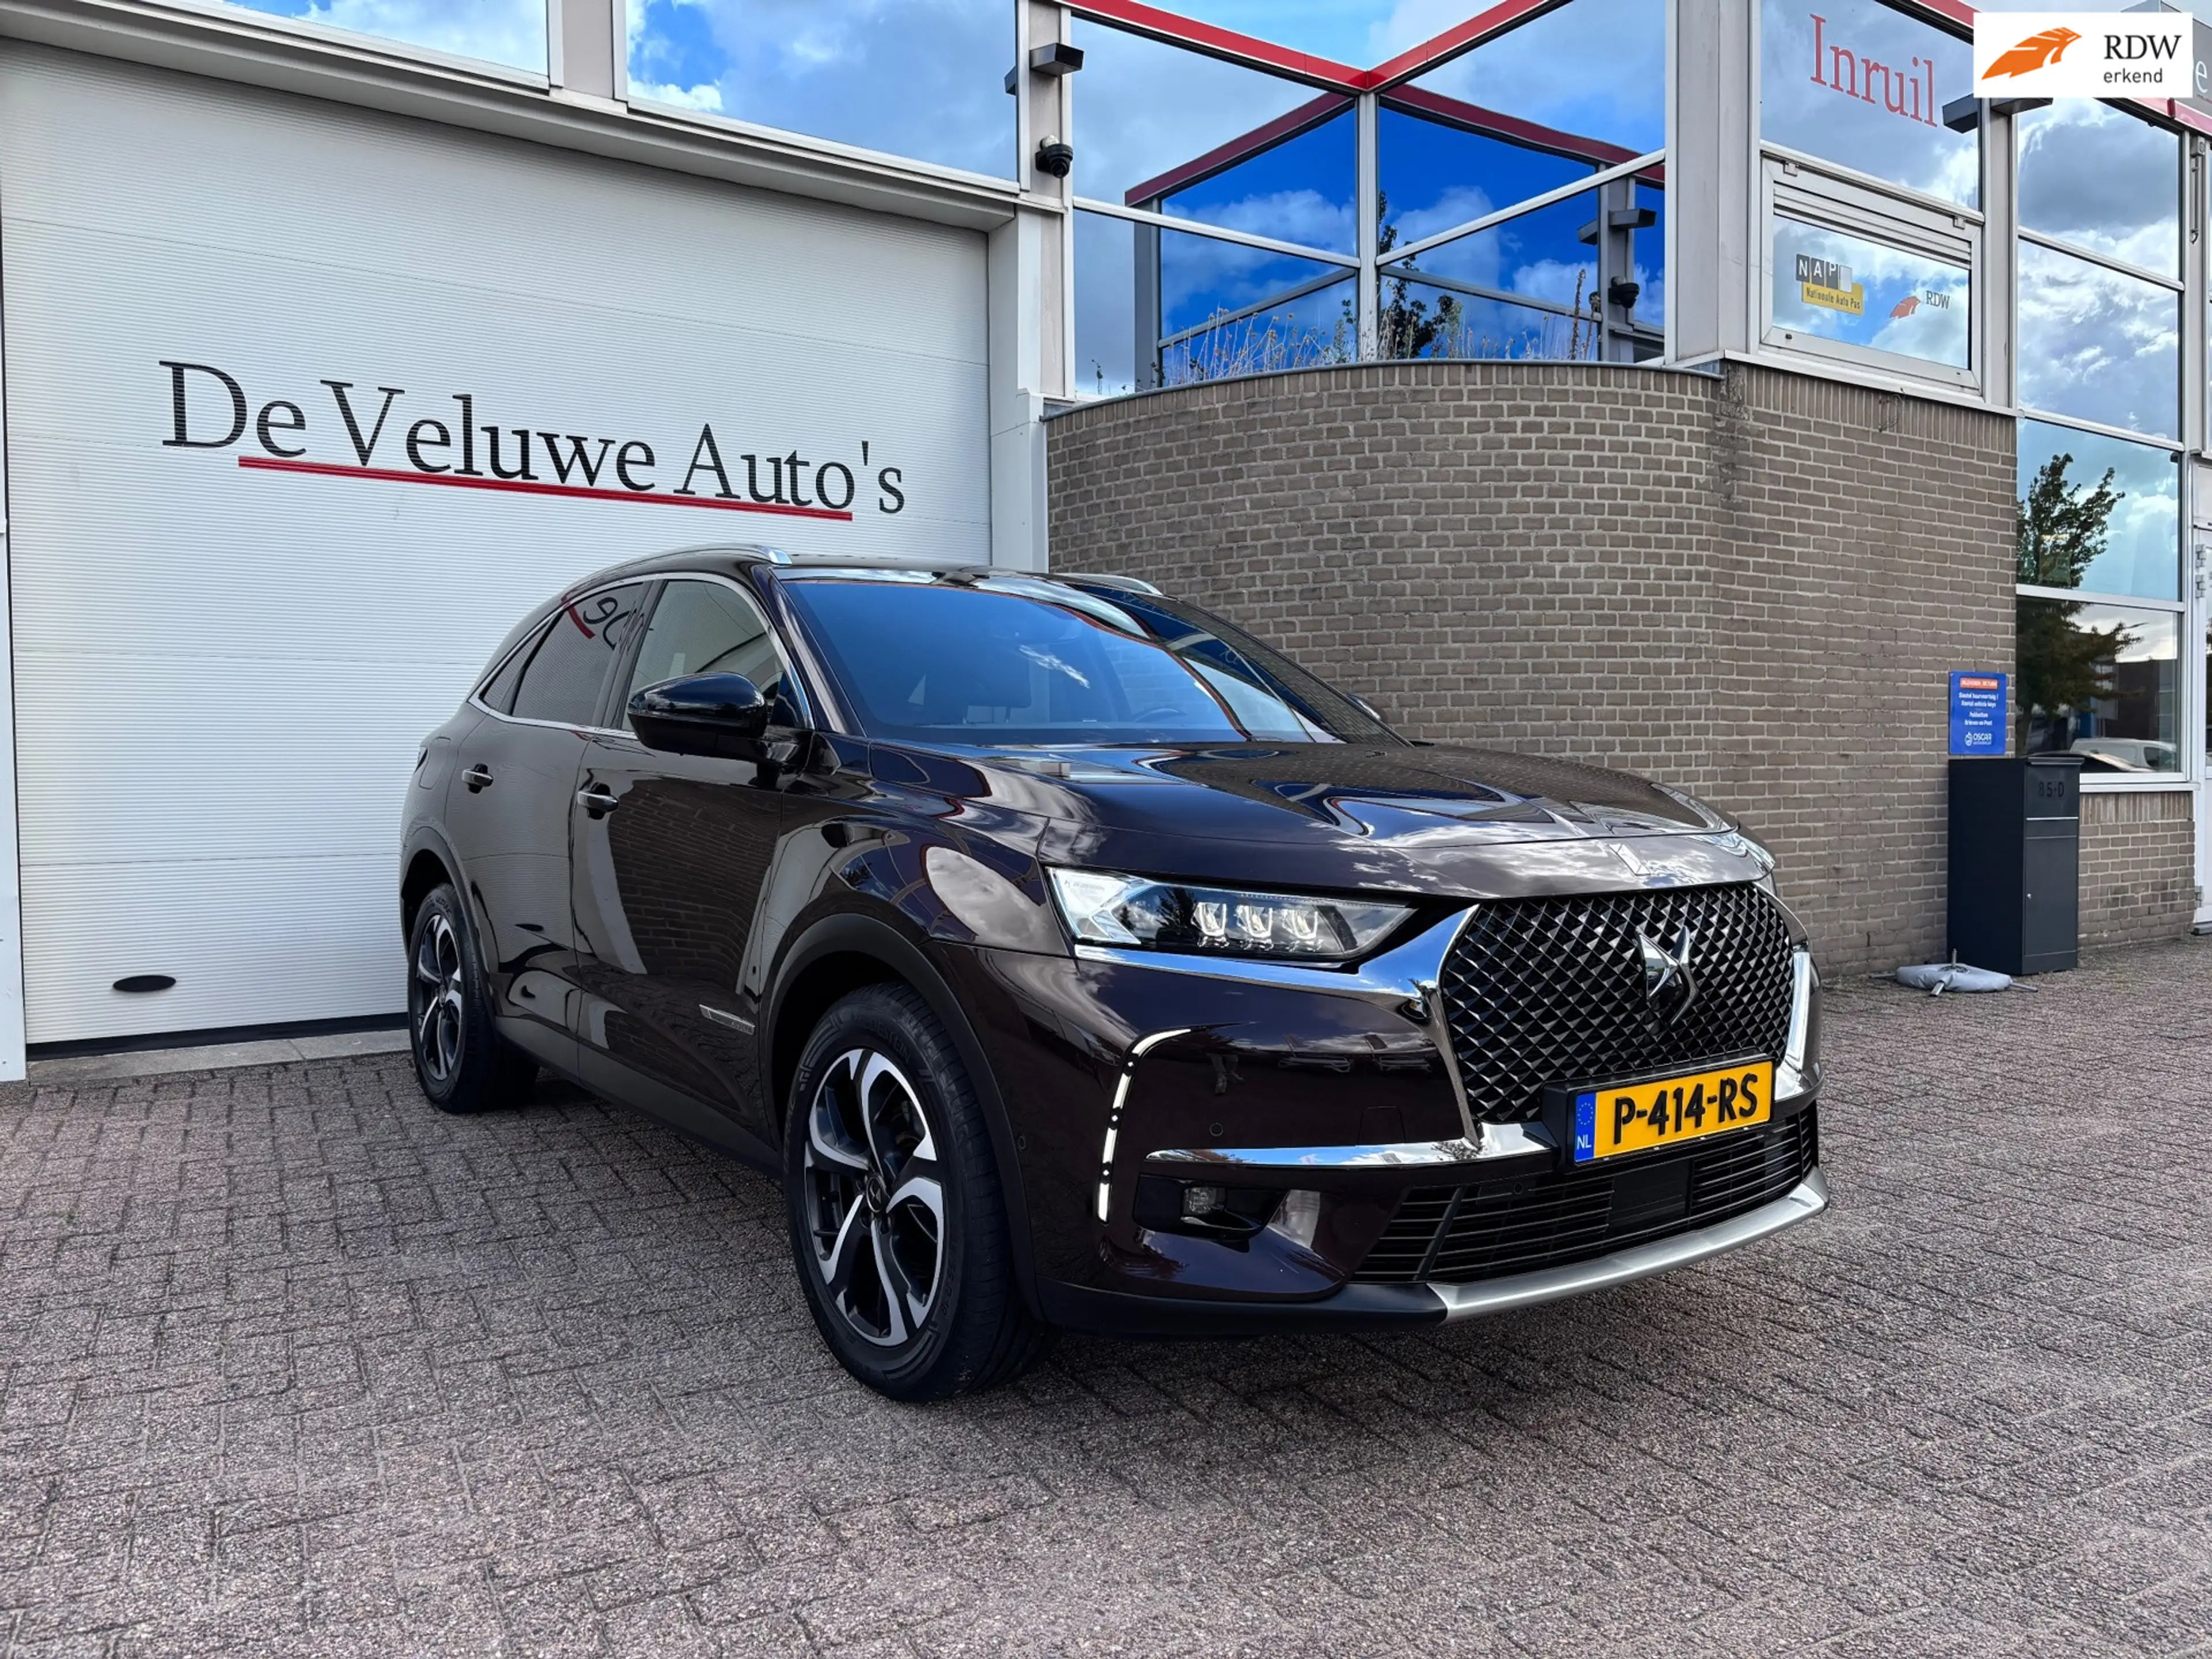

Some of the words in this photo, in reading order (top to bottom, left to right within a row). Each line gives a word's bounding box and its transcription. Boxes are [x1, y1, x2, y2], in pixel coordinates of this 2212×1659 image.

[1810, 13, 1938, 127] Inruil
[1799, 259, 1837, 278] NAP
[1806, 286, 1834, 303] Nationale
[1836, 292, 1849, 306] Auto
[1850, 297, 1861, 309] Pas
[1926, 290, 1950, 309] RDW
[159, 360, 306, 457] De
[320, 379, 656, 491] Veluwe
[673, 423, 905, 513] Auto's
[1613, 1073, 1758, 1145] P-414-RS
[1577, 1134, 1592, 1150] NL
